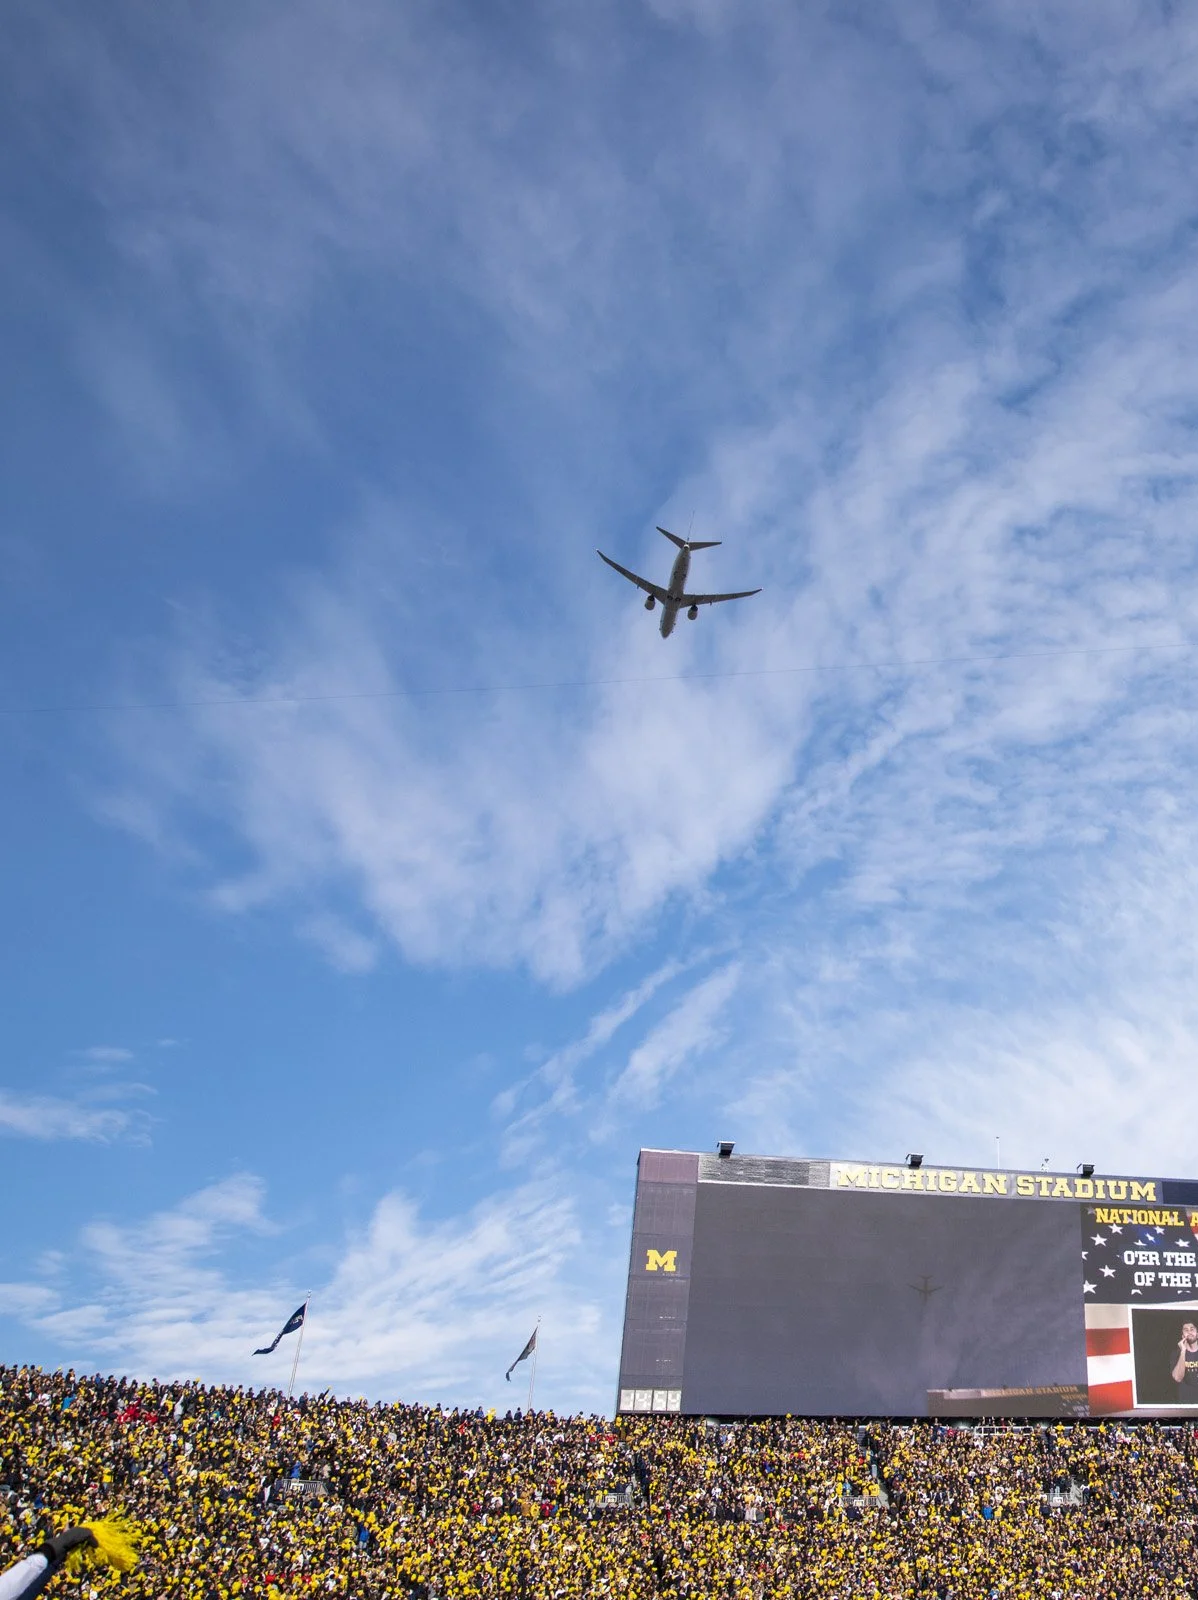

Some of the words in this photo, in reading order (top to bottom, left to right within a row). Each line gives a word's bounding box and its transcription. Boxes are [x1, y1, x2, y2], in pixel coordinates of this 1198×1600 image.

[837, 1167, 1007, 1195] MICHIGAN
[1016, 1174, 1157, 1202] STADIUM
[1095, 1208, 1185, 1226] NATIONAL
[645, 1249, 677, 1272] M
[1123, 1250, 1160, 1266] O'ER
[1163, 1252, 1197, 1267] THE
[1134, 1271, 1156, 1287] OF
[1158, 1272, 1192, 1288] THE
